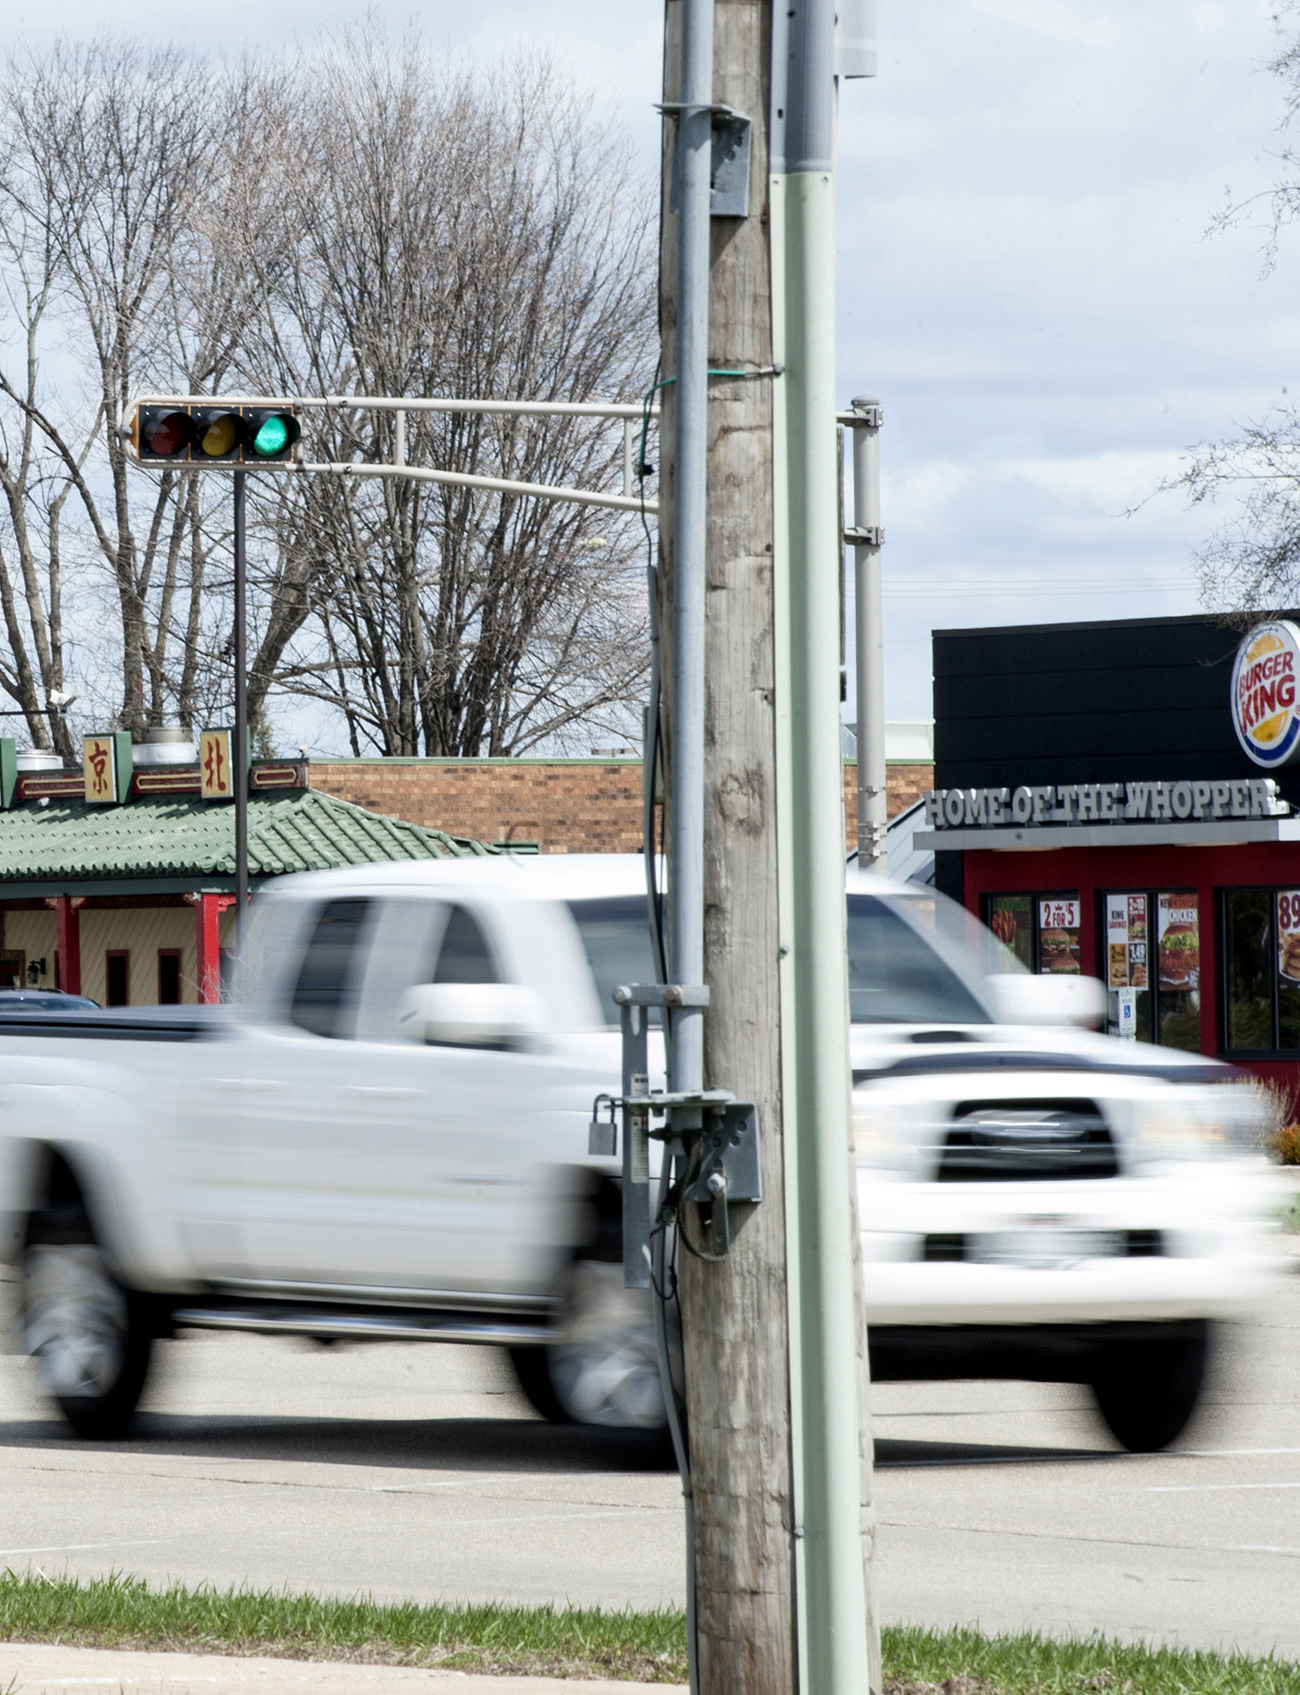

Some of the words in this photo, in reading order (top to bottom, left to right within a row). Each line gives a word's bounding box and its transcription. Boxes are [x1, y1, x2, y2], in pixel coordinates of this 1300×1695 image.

[1239, 651, 1294, 700] BURGER
[1241, 673, 1295, 735] KING
[89, 741, 108, 794] 京
[204, 736, 226, 791] 北
[924, 786, 1010, 826] HOME
[1012, 783, 1056, 823] OF
[1058, 782, 1124, 821] THE
[1125, 778, 1290, 819] WHOPPER
[1044, 903, 1051, 927] 2
[1053, 913, 1066, 927] FOR
[1169, 909, 1198, 922] CHICKEN
